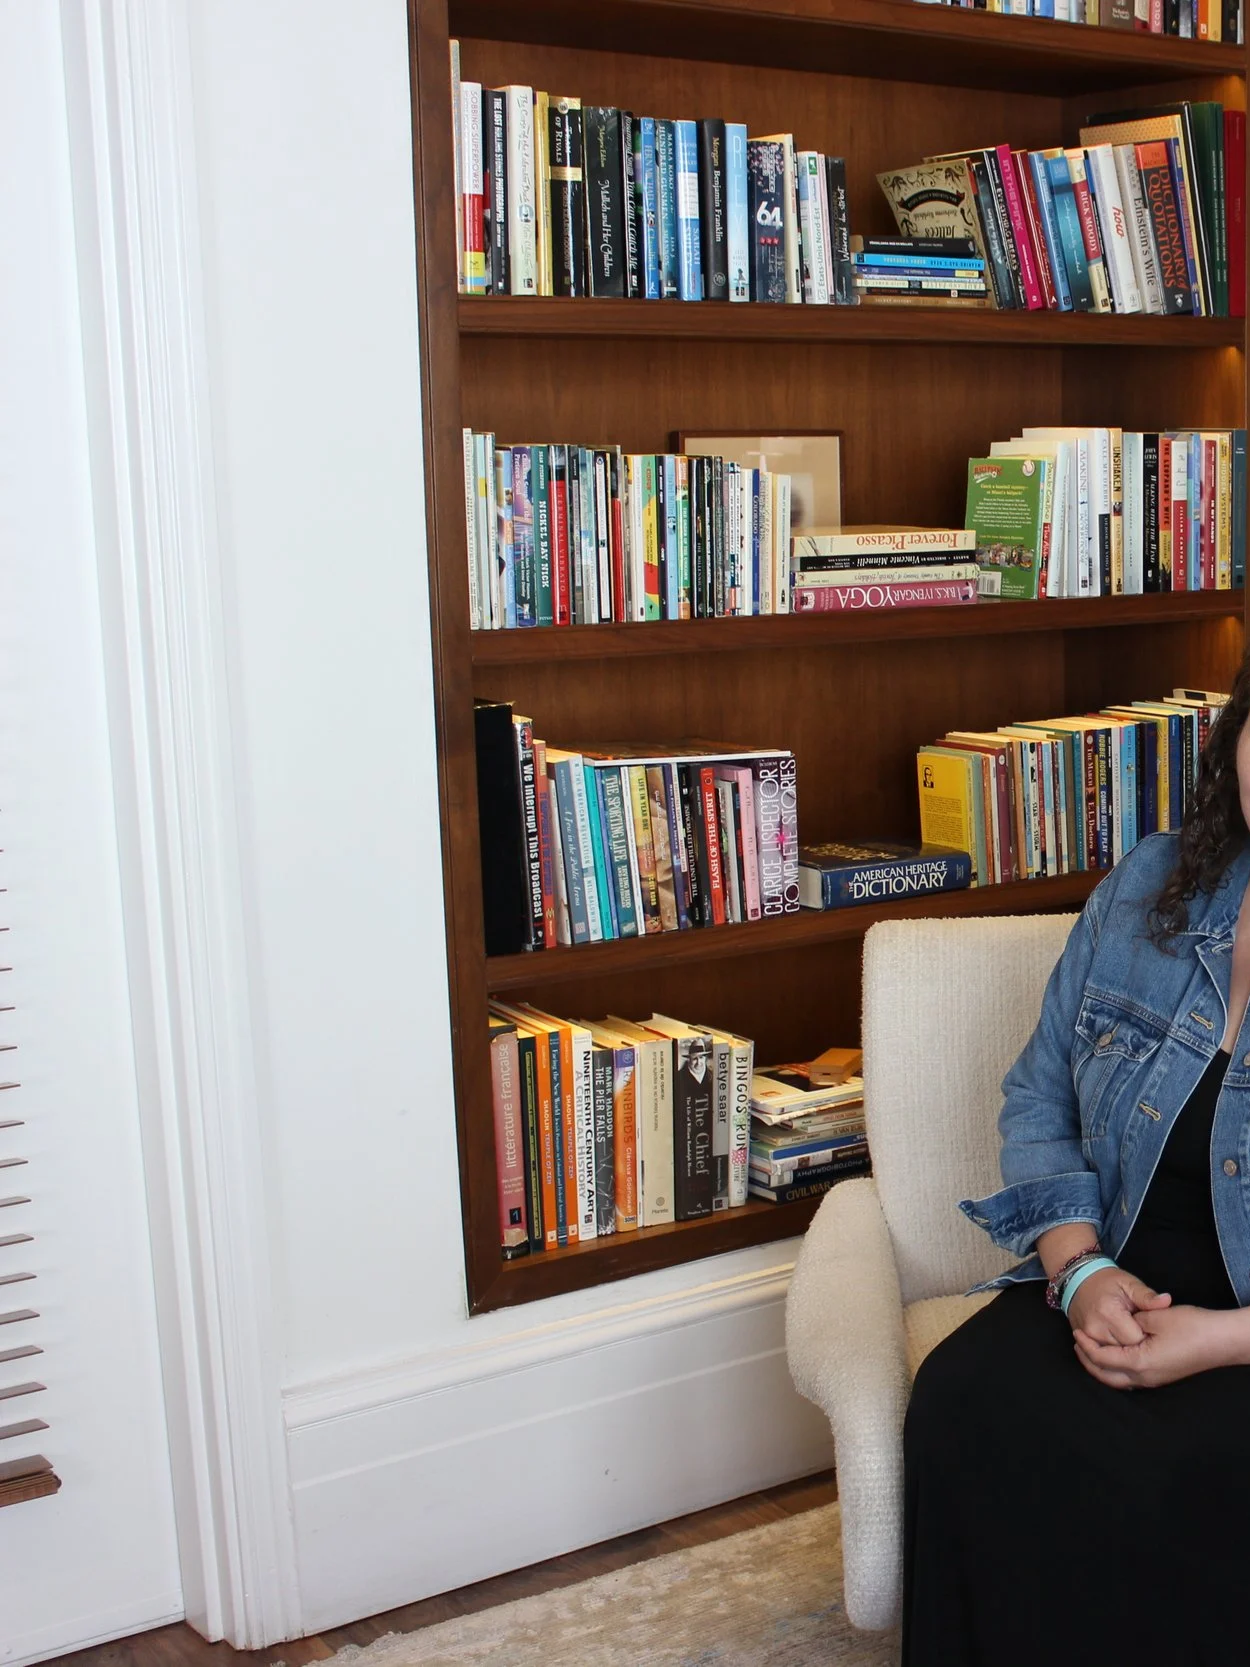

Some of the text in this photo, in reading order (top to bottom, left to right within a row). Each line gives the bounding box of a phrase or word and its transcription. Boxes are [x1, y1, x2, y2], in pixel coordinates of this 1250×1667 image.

[494, 98, 502, 109] THE
[494, 111, 503, 126] LOST
[495, 178, 504, 223] PHOTOGRAPHS
[711, 137, 723, 242] Morgan Benjamin Franklin
[756, 201, 783, 230] 64
[692, 228, 701, 265] SARAH
[1080, 191, 1097, 253] RICK MOODY
[1112, 207, 1125, 238] how
[1133, 198, 1156, 286] Einstein's Wife
[1148, 174, 1176, 288] QUOTATIONS
[514, 454, 522, 477] Preteen
[1113, 446, 1121, 492] UNSHAKEN
[856, 533, 958, 550] Forever Picasso
[834, 586, 896, 609] YOGA
[893, 588, 958, 602] B.K.S. IYENGAR
[637, 778, 646, 792] LIFE
[639, 801, 648, 817] YEAR
[523, 764, 544, 918] We Interrupt This Broadcast
[606, 775, 627, 863] THE SPORTING LIFE
[641, 819, 649, 831] ONE
[705, 791, 721, 889] FLASH OF THE SPIRIT
[759, 769, 782, 915] CLARICE LISPECTOR
[779, 759, 799, 913] COMPLETE STORIES
[853, 861, 947, 882] AMERICAN HERITAGE
[853, 871, 947, 899] DICTIONARY
[498, 1044, 517, 1168] littérature française
[550, 1049, 561, 1116] Facing the New World
[595, 1066, 606, 1143] THE PIER FALLS
[605, 1066, 614, 1138] MARK HADDON
[623, 1070, 633, 1144] RAINBIRDS
[717, 1052, 729, 1124] betye saar
[735, 1056, 748, 1152] BINGO'S RUN
[575, 1070, 587, 1198] A CRITICAL HISTORY
[583, 1050, 595, 1214] NINETEENTH CENTURY ART
[695, 1093, 710, 1176] The Chief
[786, 1184, 808, 1201] CIVIL
